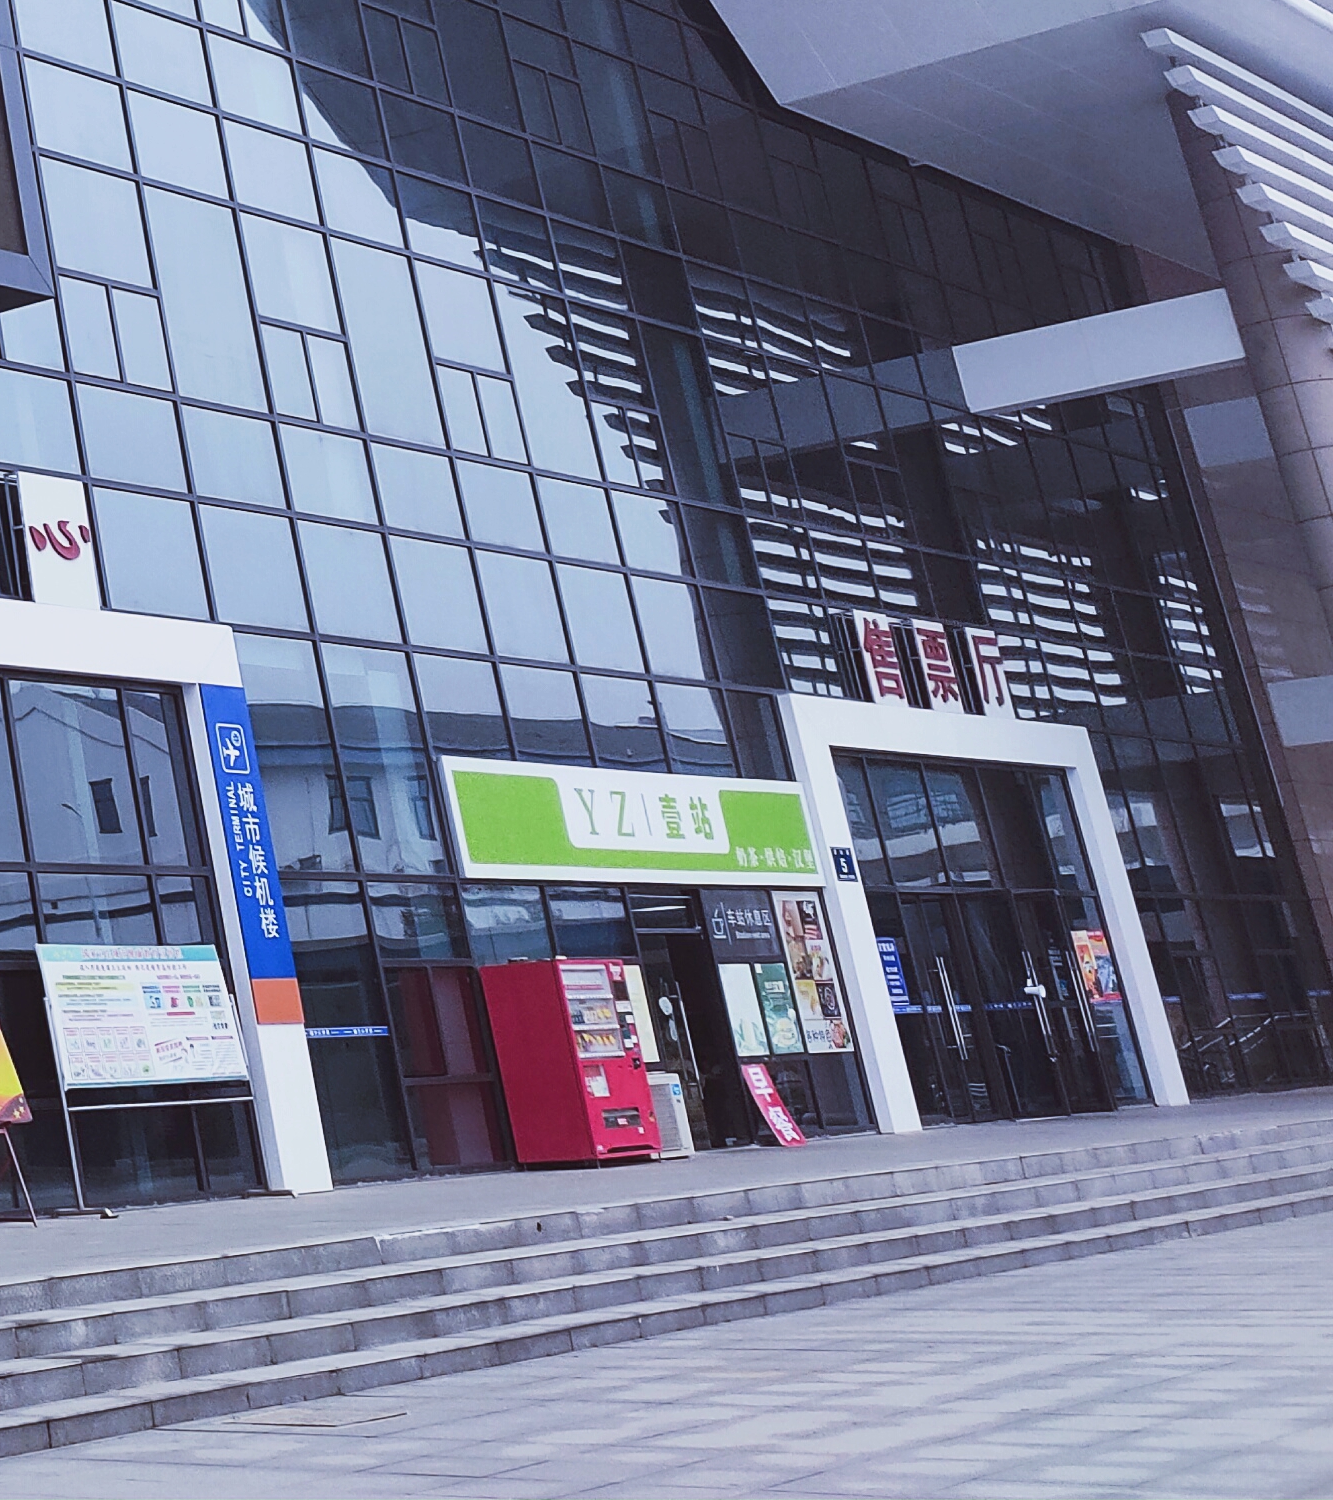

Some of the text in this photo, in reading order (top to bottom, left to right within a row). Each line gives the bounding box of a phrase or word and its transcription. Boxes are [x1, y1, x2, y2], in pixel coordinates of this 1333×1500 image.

[863, 616, 1005, 707] 售票厅
[225, 781, 253, 897] CITY TERMINAL
[658, 793, 715, 841] 壹站
[236, 782, 280, 939] 城市候机楼
[839, 857, 849, 874] 5
[725, 908, 773, 927] 车站休息区
[747, 1067, 801, 1142] 早餐
